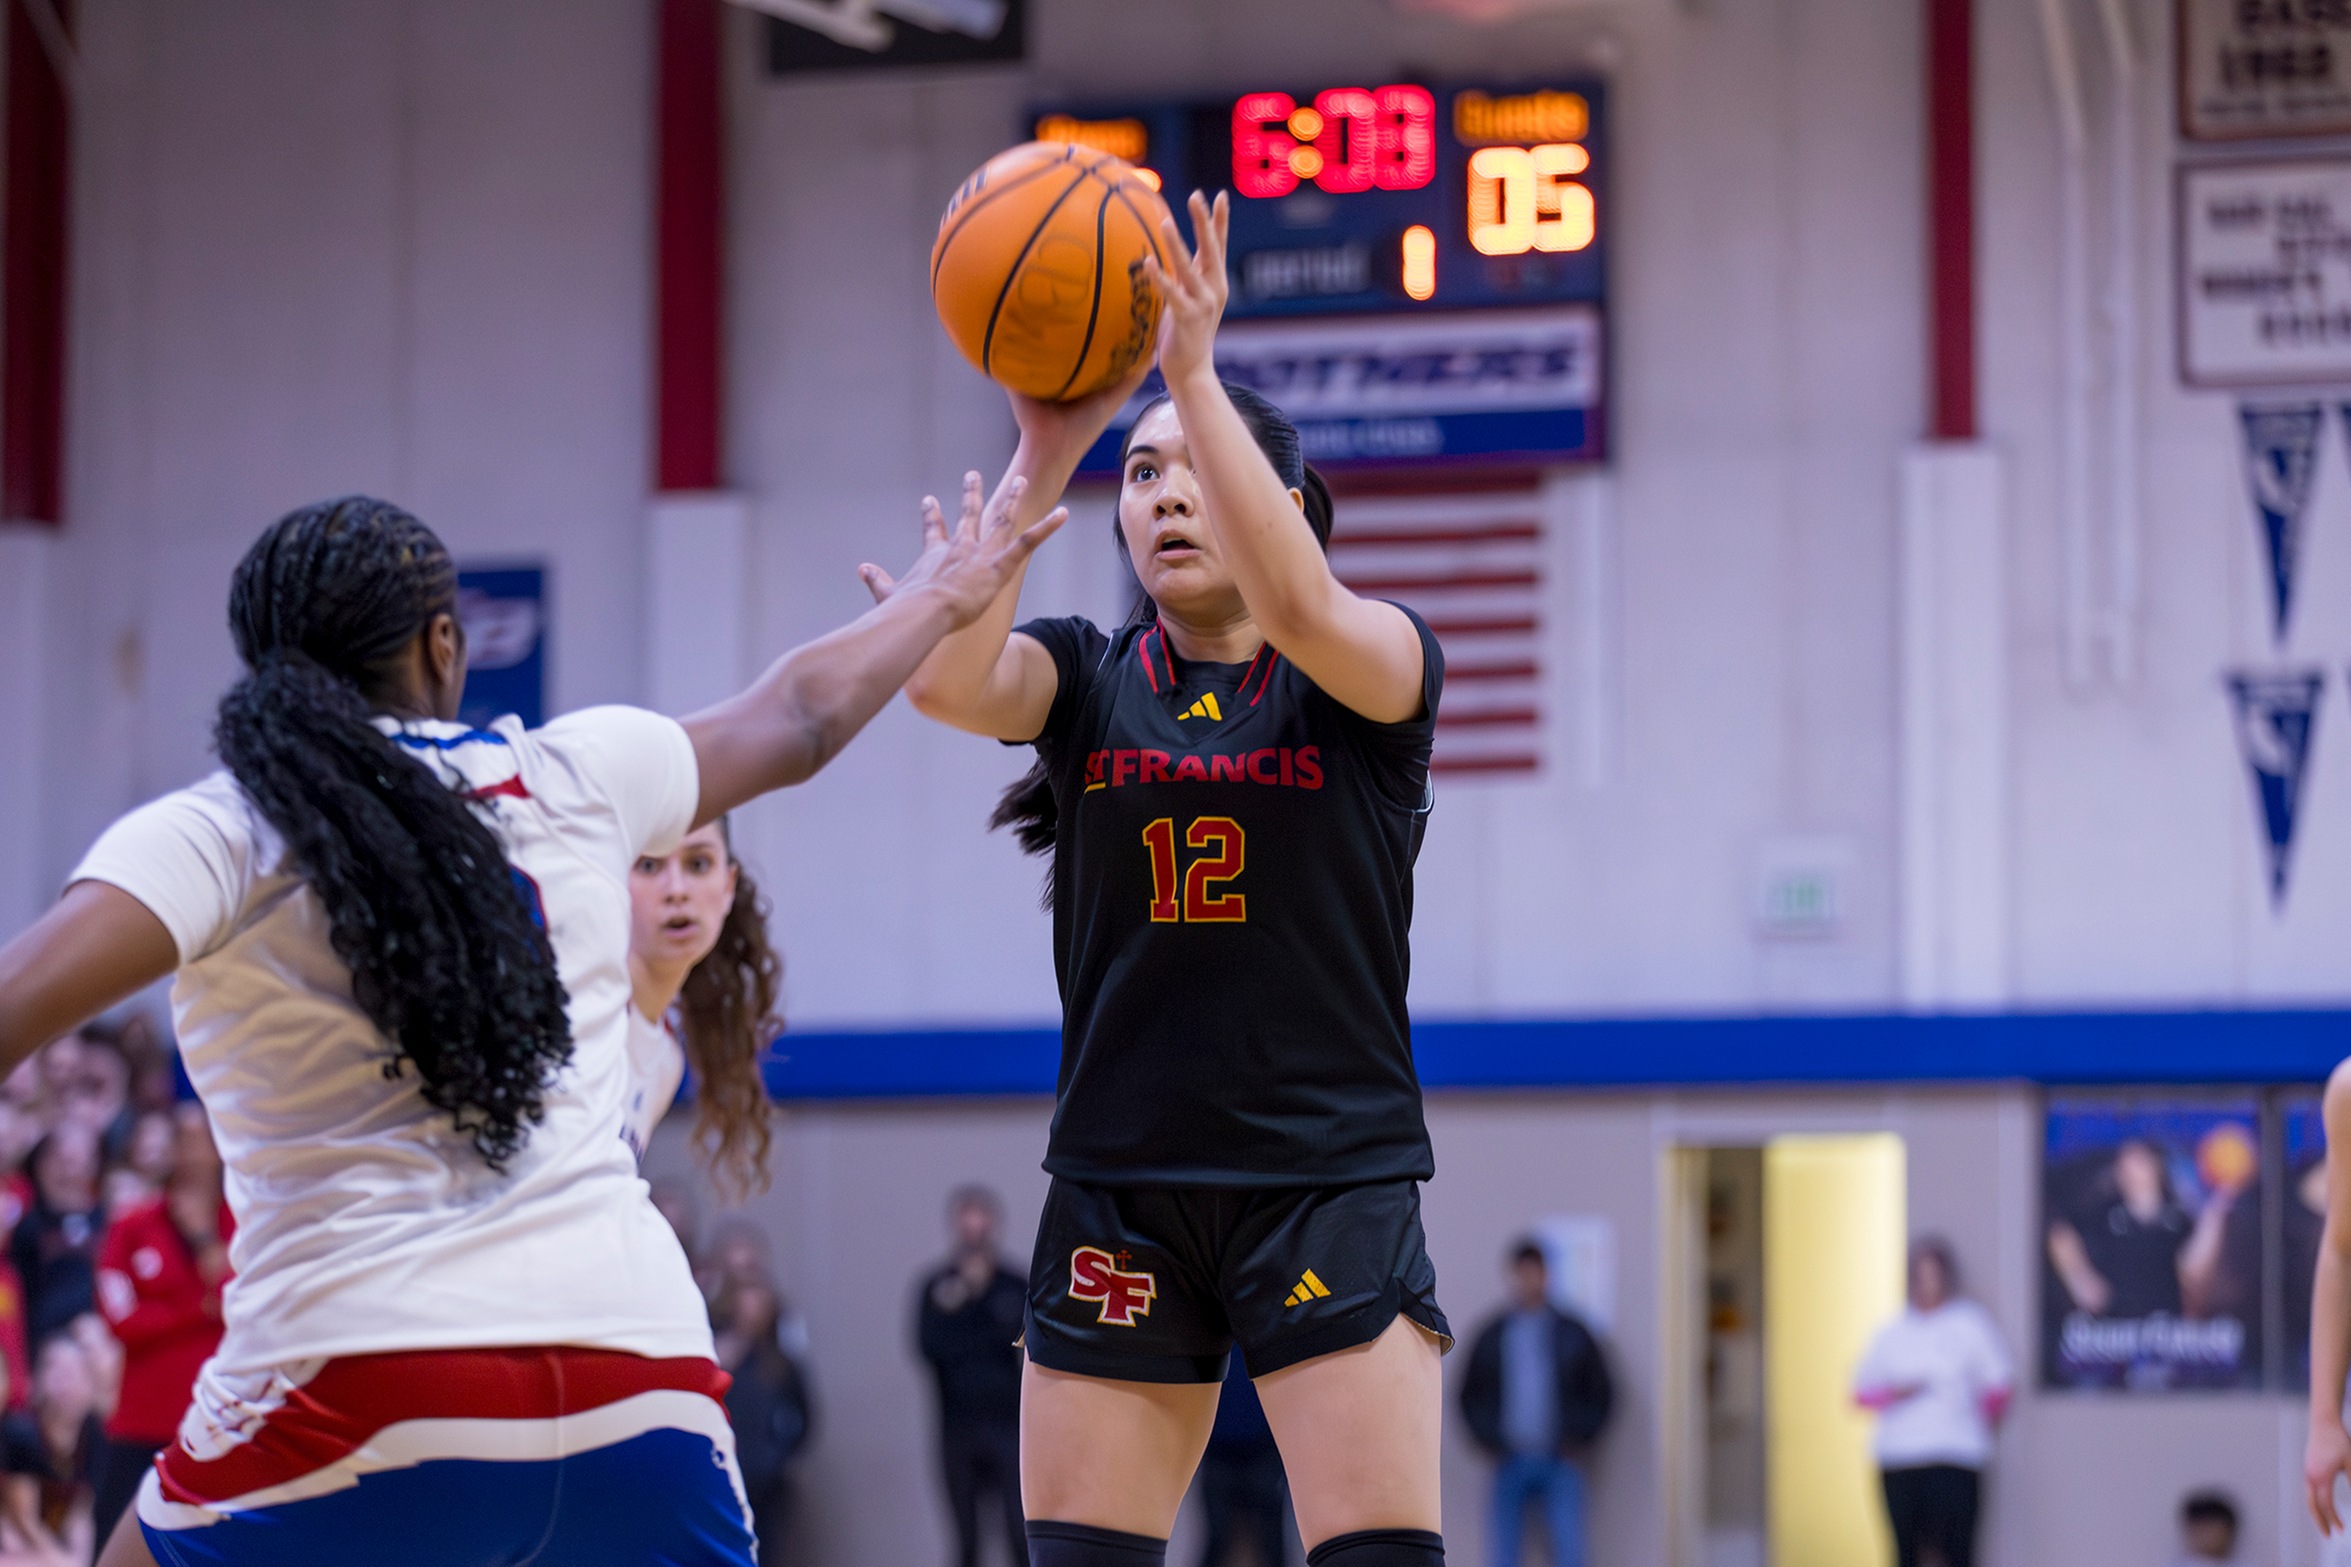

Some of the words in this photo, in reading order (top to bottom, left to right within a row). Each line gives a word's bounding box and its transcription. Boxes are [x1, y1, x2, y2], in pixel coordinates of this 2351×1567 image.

[1231, 84, 1436, 198] 6:08
[1467, 143, 1595, 256] 05
[1401, 225, 1437, 301] 1
[1141, 816, 1247, 923] 12
[1068, 1245, 1158, 1328] SF
